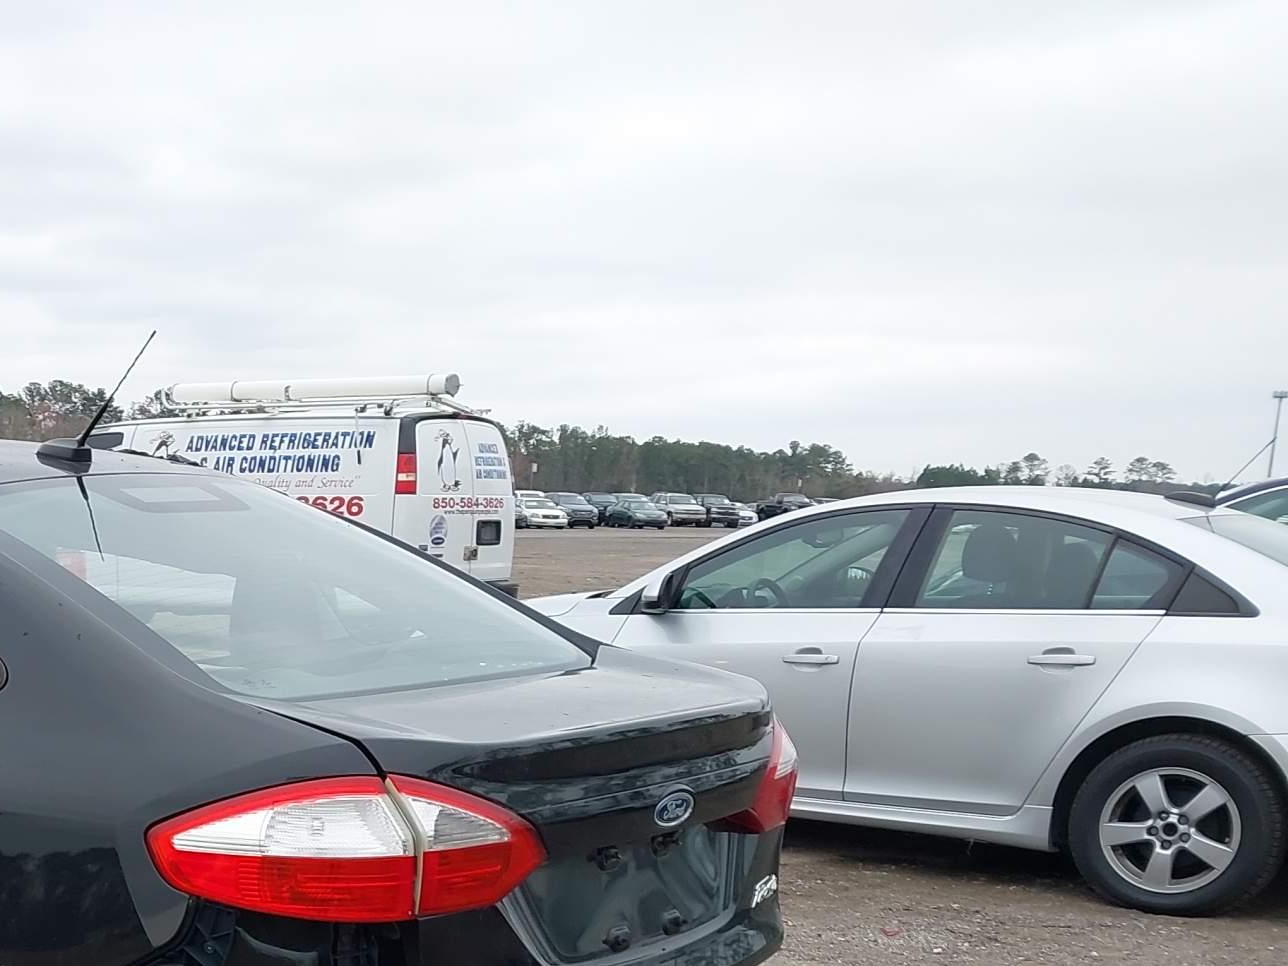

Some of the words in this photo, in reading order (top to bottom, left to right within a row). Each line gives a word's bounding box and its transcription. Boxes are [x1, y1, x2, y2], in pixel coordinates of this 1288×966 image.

[185, 433, 256, 452] ADVANCED
[259, 431, 376, 450] REFRIGERATION
[213, 456, 235, 474] AIR
[238, 454, 340, 473] CONDITIONING
[294, 475, 317, 488] and
[432, 497, 504, 509] 850-584-3626
